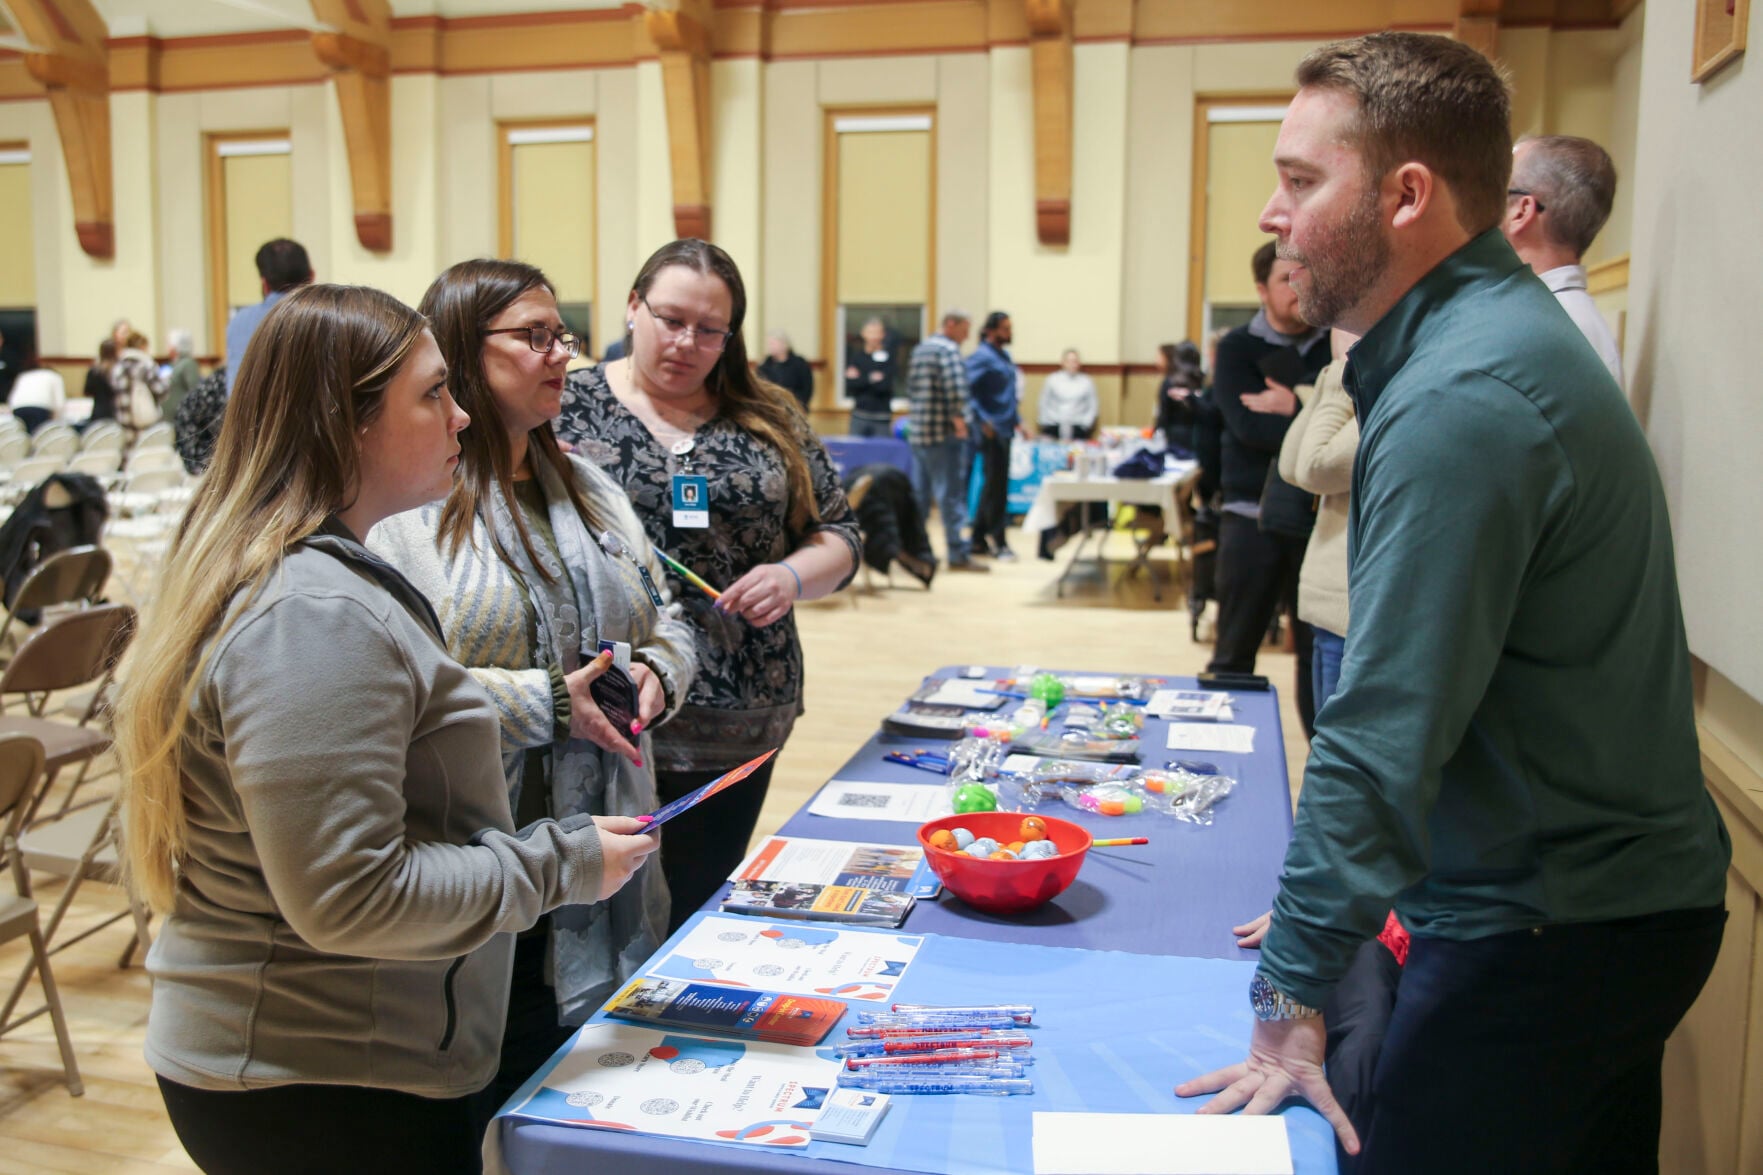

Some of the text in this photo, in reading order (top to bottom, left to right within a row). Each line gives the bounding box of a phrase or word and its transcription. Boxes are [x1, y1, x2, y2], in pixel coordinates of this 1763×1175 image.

[915, 1041, 958, 1049] SPECTRUM
[745, 1075, 762, 1088] Want
[732, 1096, 750, 1111] Help?
[774, 1081, 798, 1112] SPECTRUM
